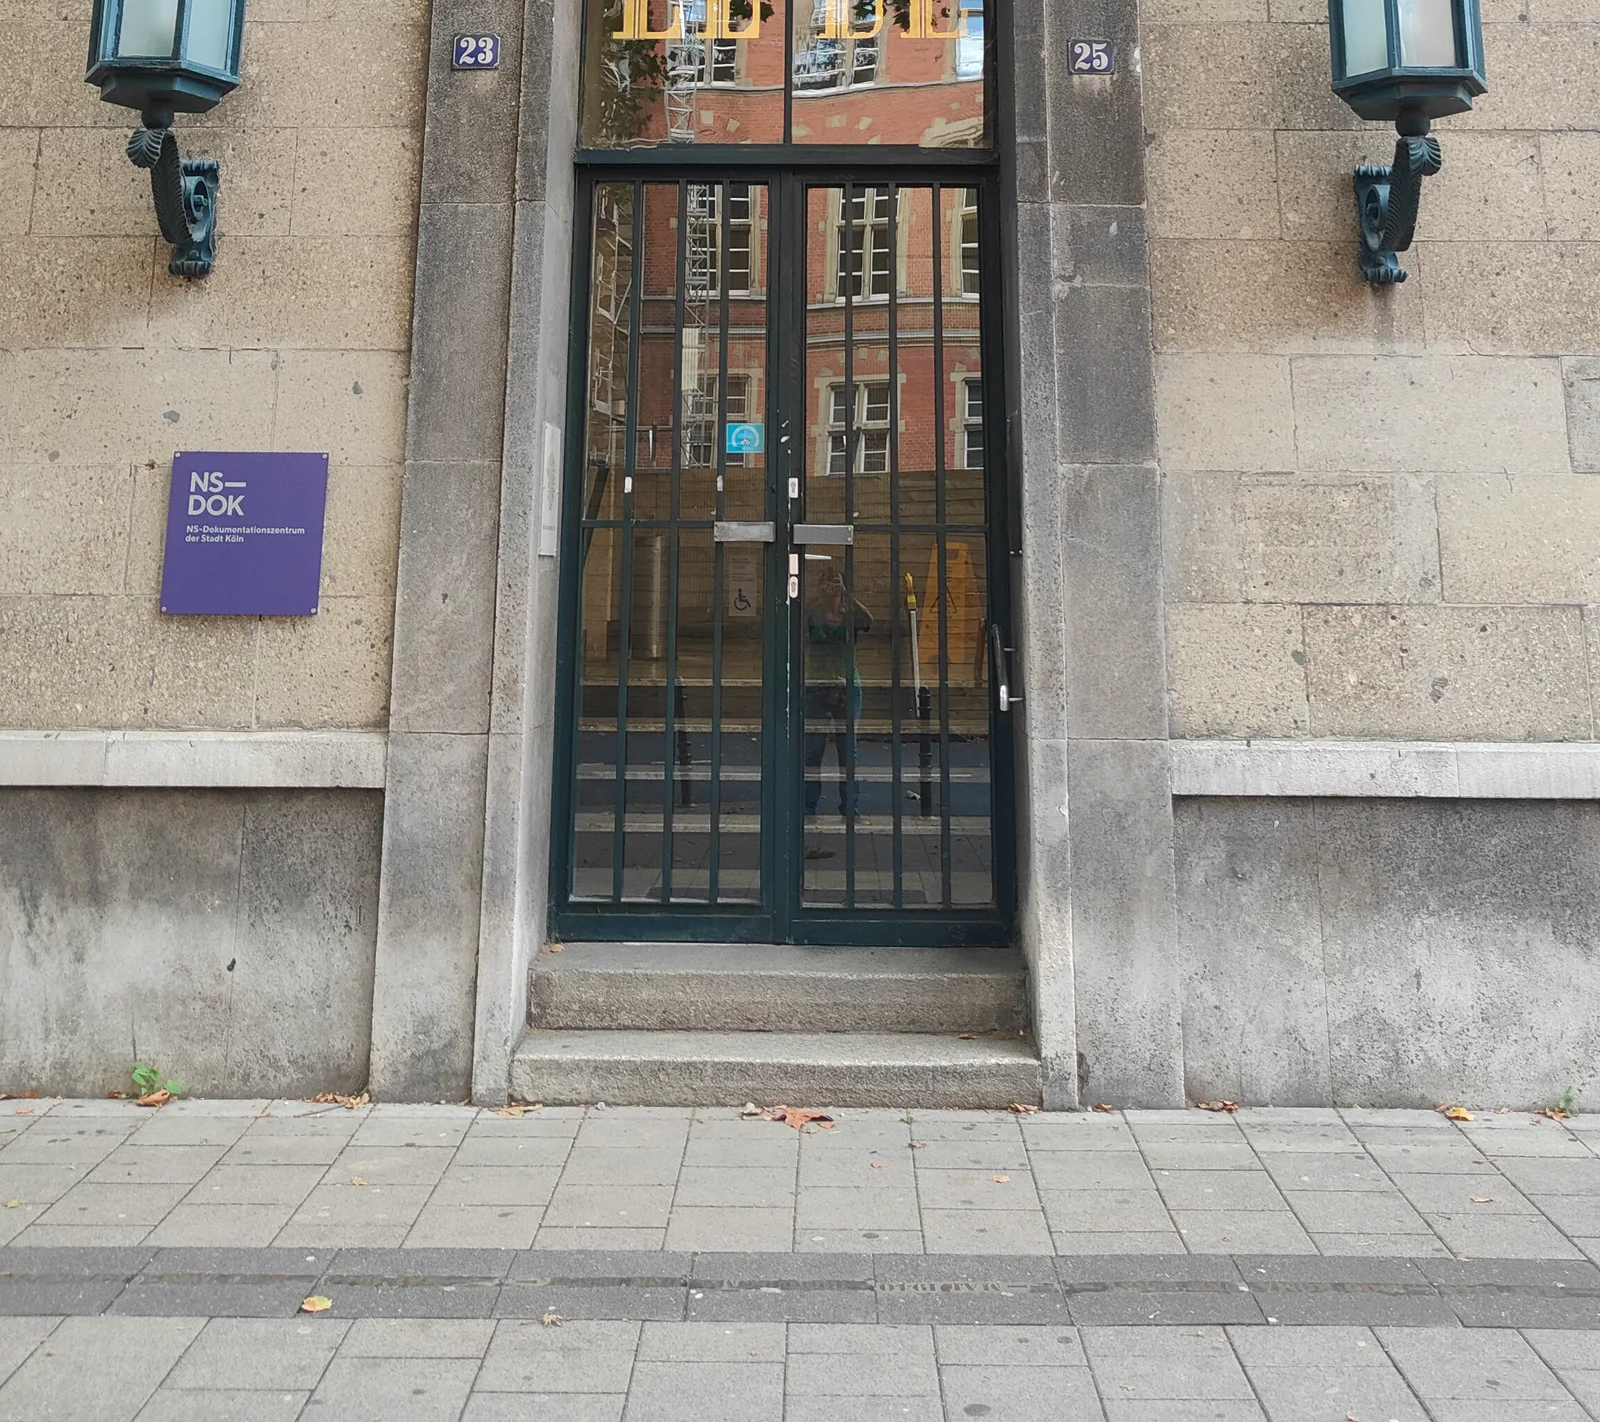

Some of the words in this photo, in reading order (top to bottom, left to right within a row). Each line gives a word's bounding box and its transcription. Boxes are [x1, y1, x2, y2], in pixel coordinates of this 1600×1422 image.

[459, 36, 494, 65] 23
[1073, 42, 1109, 70] 25
[187, 494, 246, 516] DOK
[185, 534, 199, 543] der
[200, 534, 223, 543] Stadt
[225, 534, 244, 543] Köln
[186, 525, 305, 535] NS-Dokumentationszentrum
